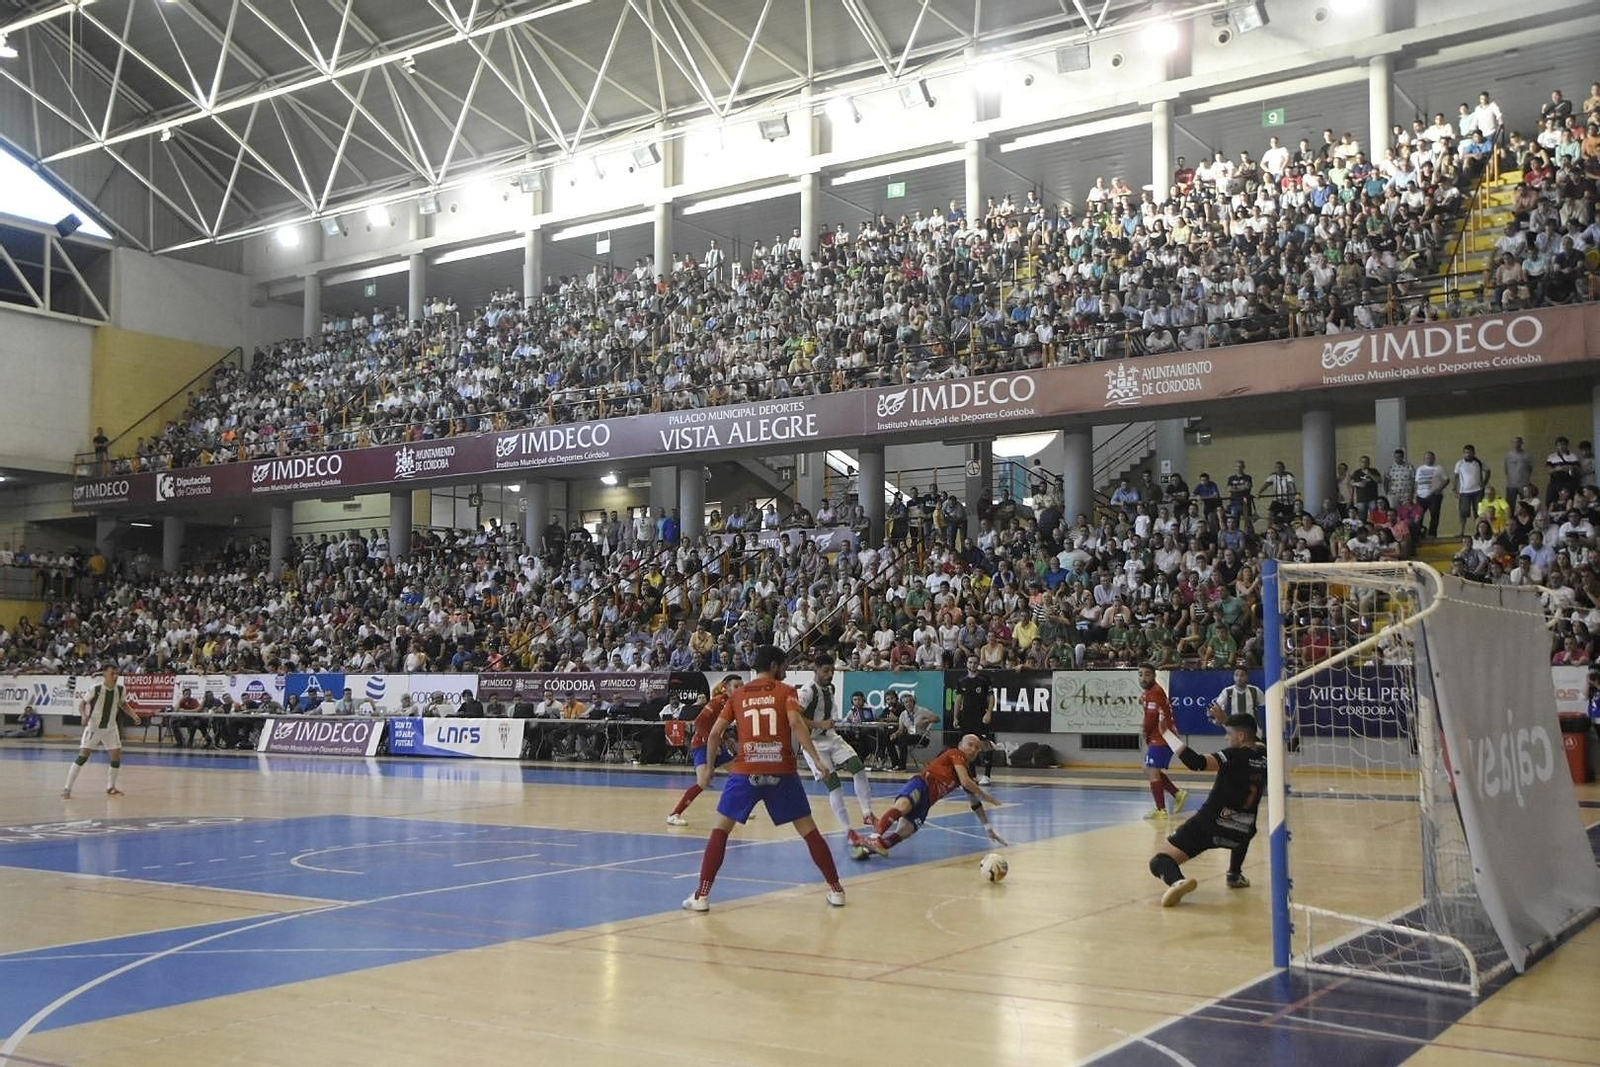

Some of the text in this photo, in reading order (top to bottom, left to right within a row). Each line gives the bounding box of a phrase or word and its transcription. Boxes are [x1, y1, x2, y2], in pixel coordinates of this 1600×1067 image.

[1268, 112, 1278, 124] 9
[1370, 315, 1543, 364] IMDECO
[1142, 361, 1212, 381] AYUNTAMIENTO
[1323, 353, 1542, 385] Instituto Municipal de Deportes Córdoba
[912, 375, 1035, 413] IMDECO
[1142, 383, 1154, 396] DE
[669, 401, 805, 425] PALACIO MUNICIPAL DEPORTES
[877, 406, 1035, 431] Instituto Municipal de Deportes Córdoba
[521, 424, 610, 454] IMDECO
[660, 413, 819, 451] VISTA ALEGRE
[415, 446, 455, 460] AYUNTAMIENTO
[496, 460, 519, 469] Instituto
[520, 457, 547, 468] Municipal
[556, 453, 583, 465] Deportes
[272, 455, 343, 480] IMDECO
[415, 461, 423, 471] DE
[177, 475, 211, 487] Diputación
[782, 469, 791, 480] H
[85, 480, 130, 499] IMDECO
[177, 488, 185, 497] de
[125, 675, 152, 686] TROFEOS
[488, 678, 512, 687] IMDECO
[544, 676, 595, 691] CÓRDOBA
[607, 679, 637, 688] IMDECO
[1060, 684, 1142, 710] Antar
[1309, 687, 1376, 701] MIGUEL
[294, 721, 369, 743] IMDECO
